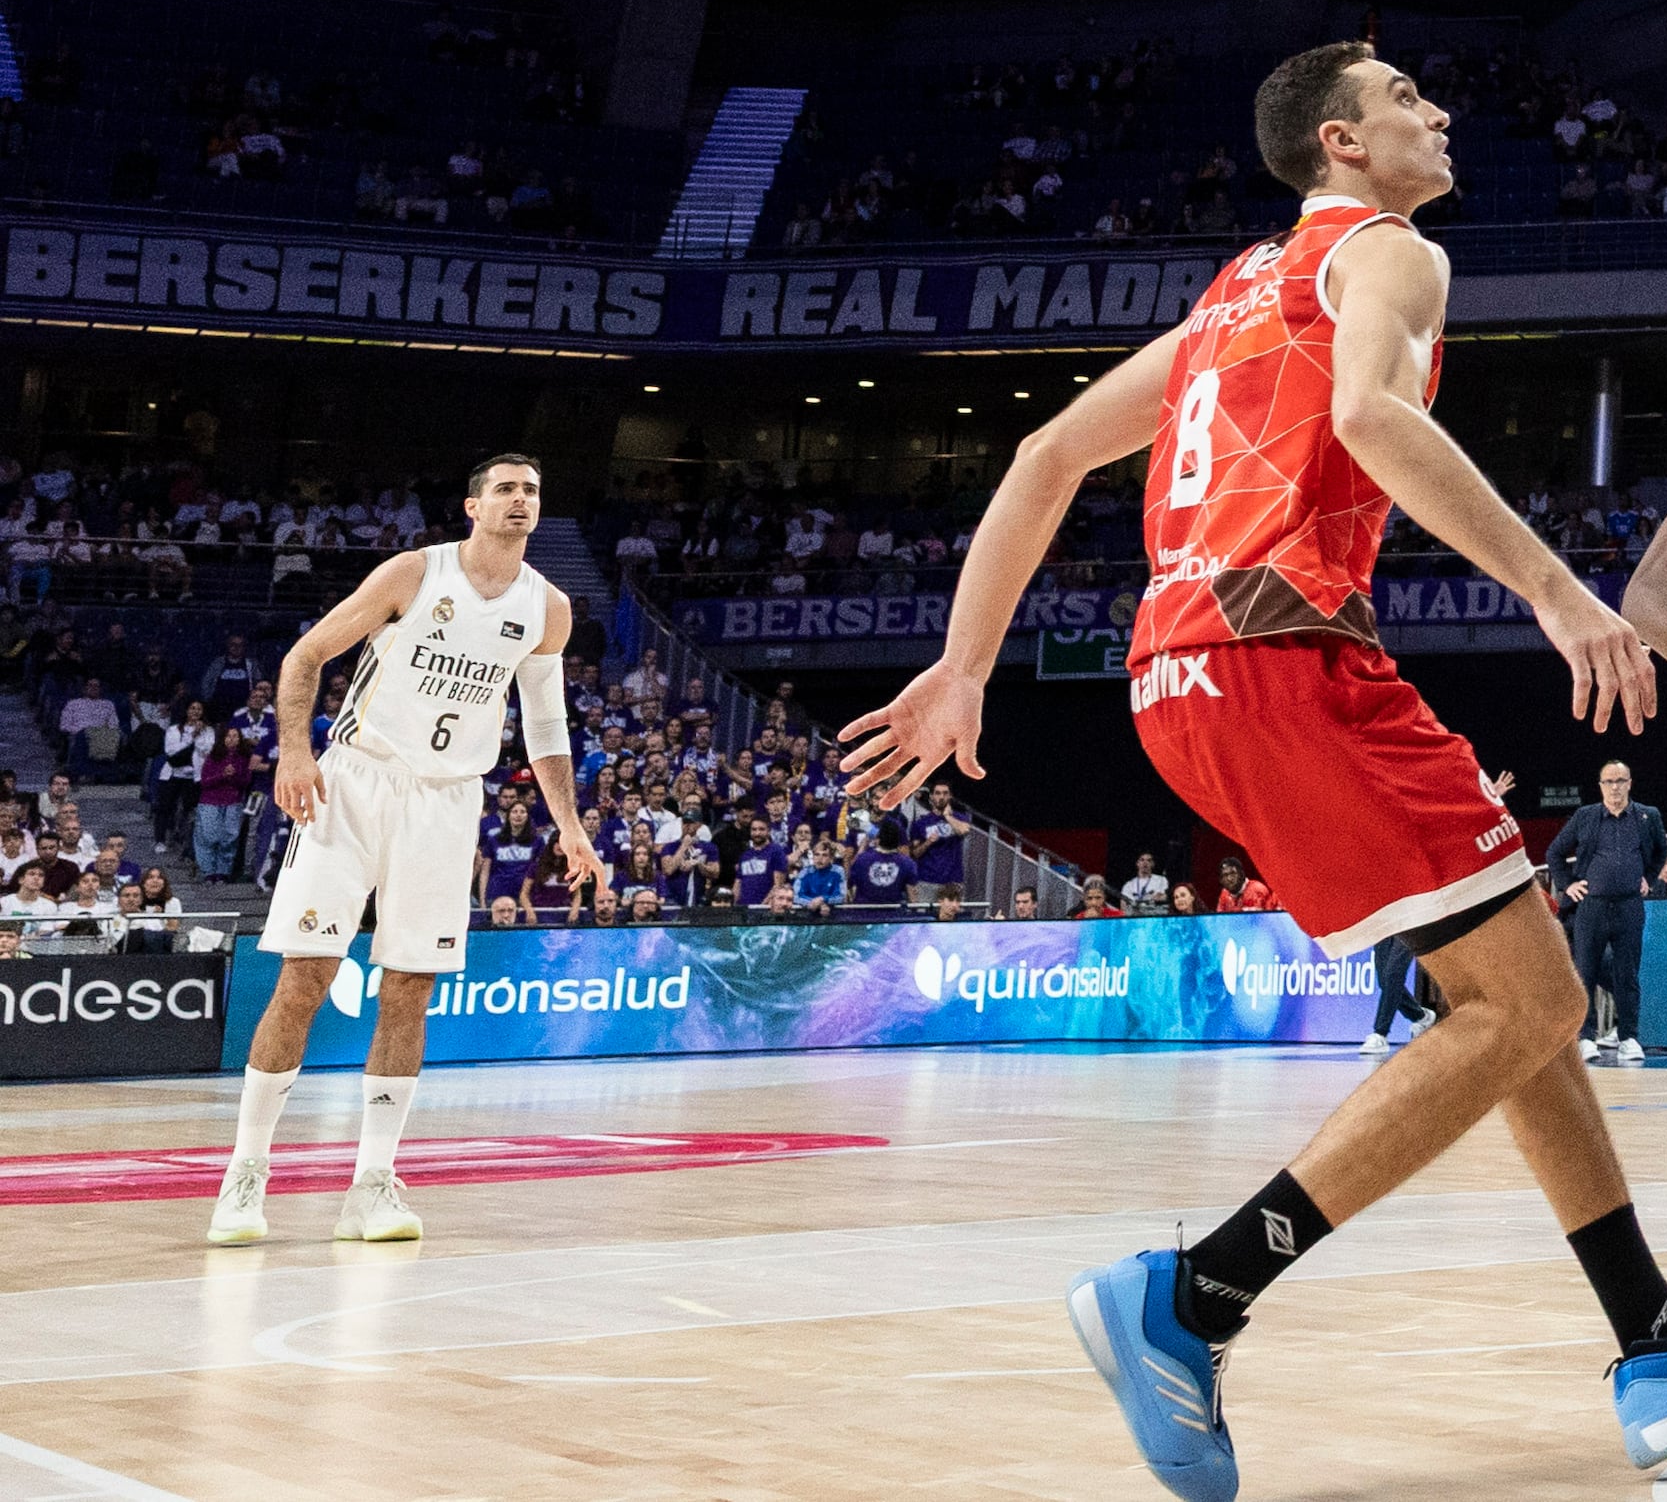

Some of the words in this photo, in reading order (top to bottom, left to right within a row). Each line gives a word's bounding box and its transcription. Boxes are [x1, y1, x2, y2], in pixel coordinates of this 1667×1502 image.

[4, 227, 666, 337] BERSERKERS
[720, 268, 937, 337] REAL
[967, 260, 1217, 329] MADR
[1170, 367, 1221, 510] 8
[722, 589, 1101, 640] BERSERRS
[418, 675, 447, 698] FLY
[430, 712, 460, 752] 6
[425, 966, 689, 1016] uirónsalud
[959, 956, 1130, 1012] quirónsalud
[1243, 950, 1376, 1010] quirónsalud
